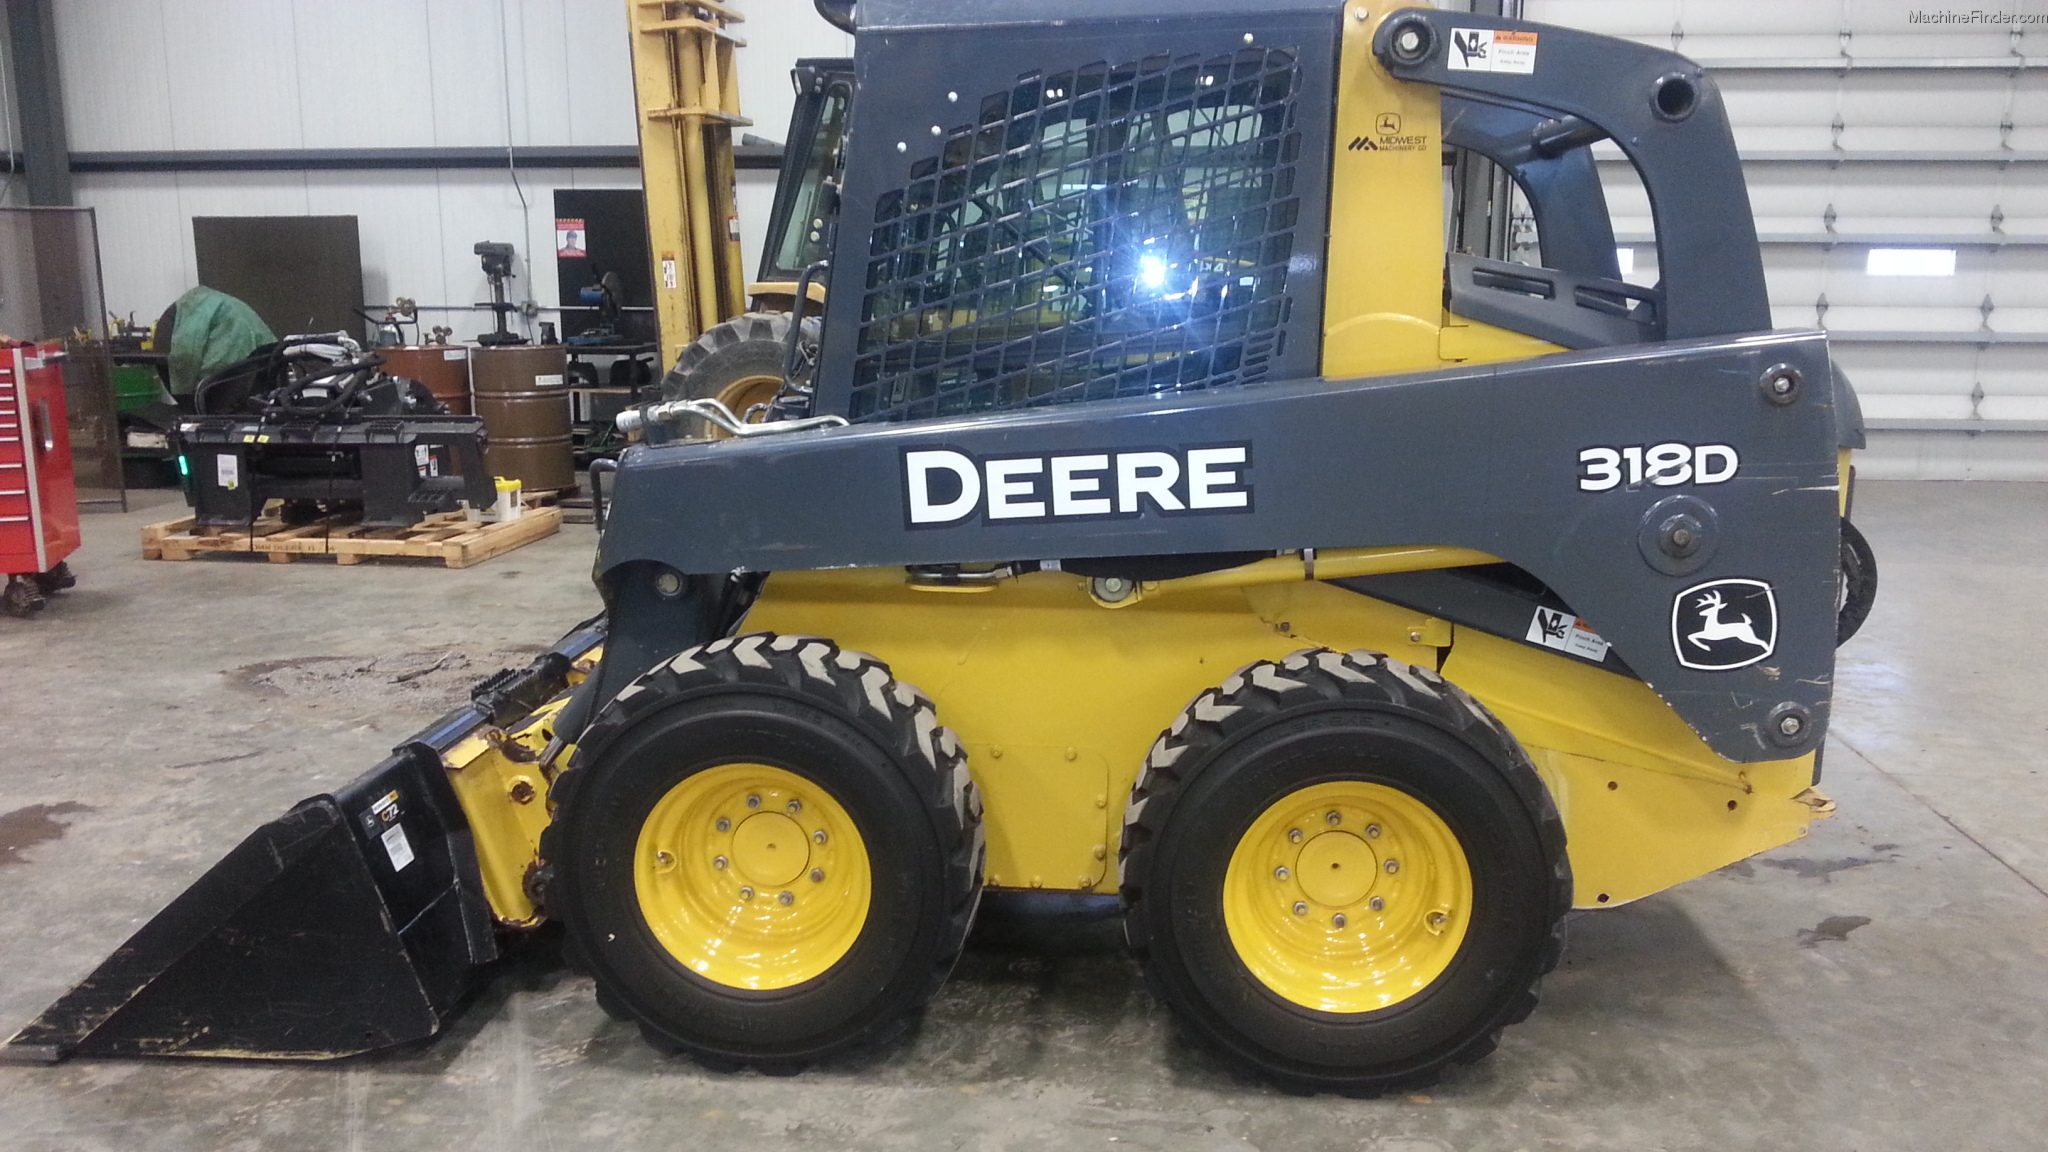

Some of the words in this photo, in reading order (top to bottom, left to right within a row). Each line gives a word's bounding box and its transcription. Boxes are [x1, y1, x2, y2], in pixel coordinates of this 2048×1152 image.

[1379, 136, 1427, 144] MIDWEST
[1579, 443, 1739, 491] 318D
[906, 447, 1248, 524] DEERE
[381, 803, 400, 822] C72
